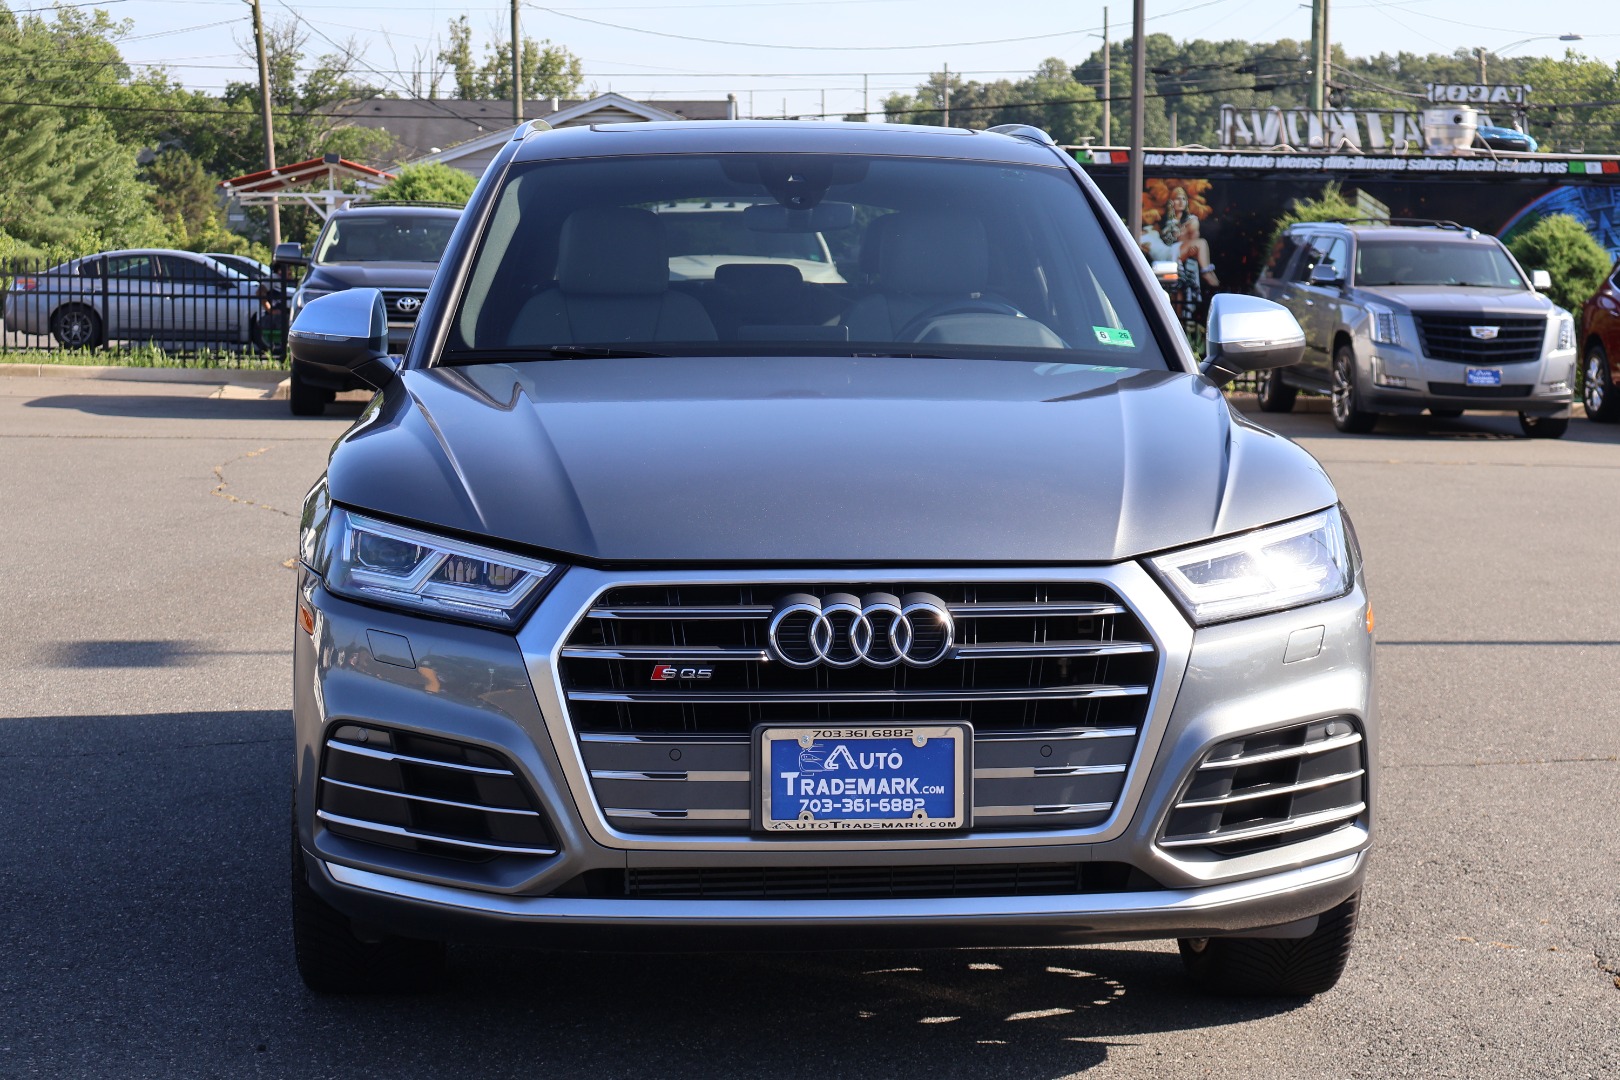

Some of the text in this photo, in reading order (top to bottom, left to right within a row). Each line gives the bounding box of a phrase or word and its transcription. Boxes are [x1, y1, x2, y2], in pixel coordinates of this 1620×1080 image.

[1144, 153, 1164, 165] no
[1164, 152, 1209, 167] sabes
[1208, 153, 1229, 167] de
[1228, 153, 1275, 168] donde
[1275, 154, 1323, 168] vienes
[1407, 156, 1456, 172] sabras
[1456, 157, 1496, 172] hacia
[1543, 161, 1569, 174] vas
[660, 667, 713, 679] SQ5
[812, 729, 914, 738] 703.361.6882
[799, 798, 926, 813] 703-361-6882
